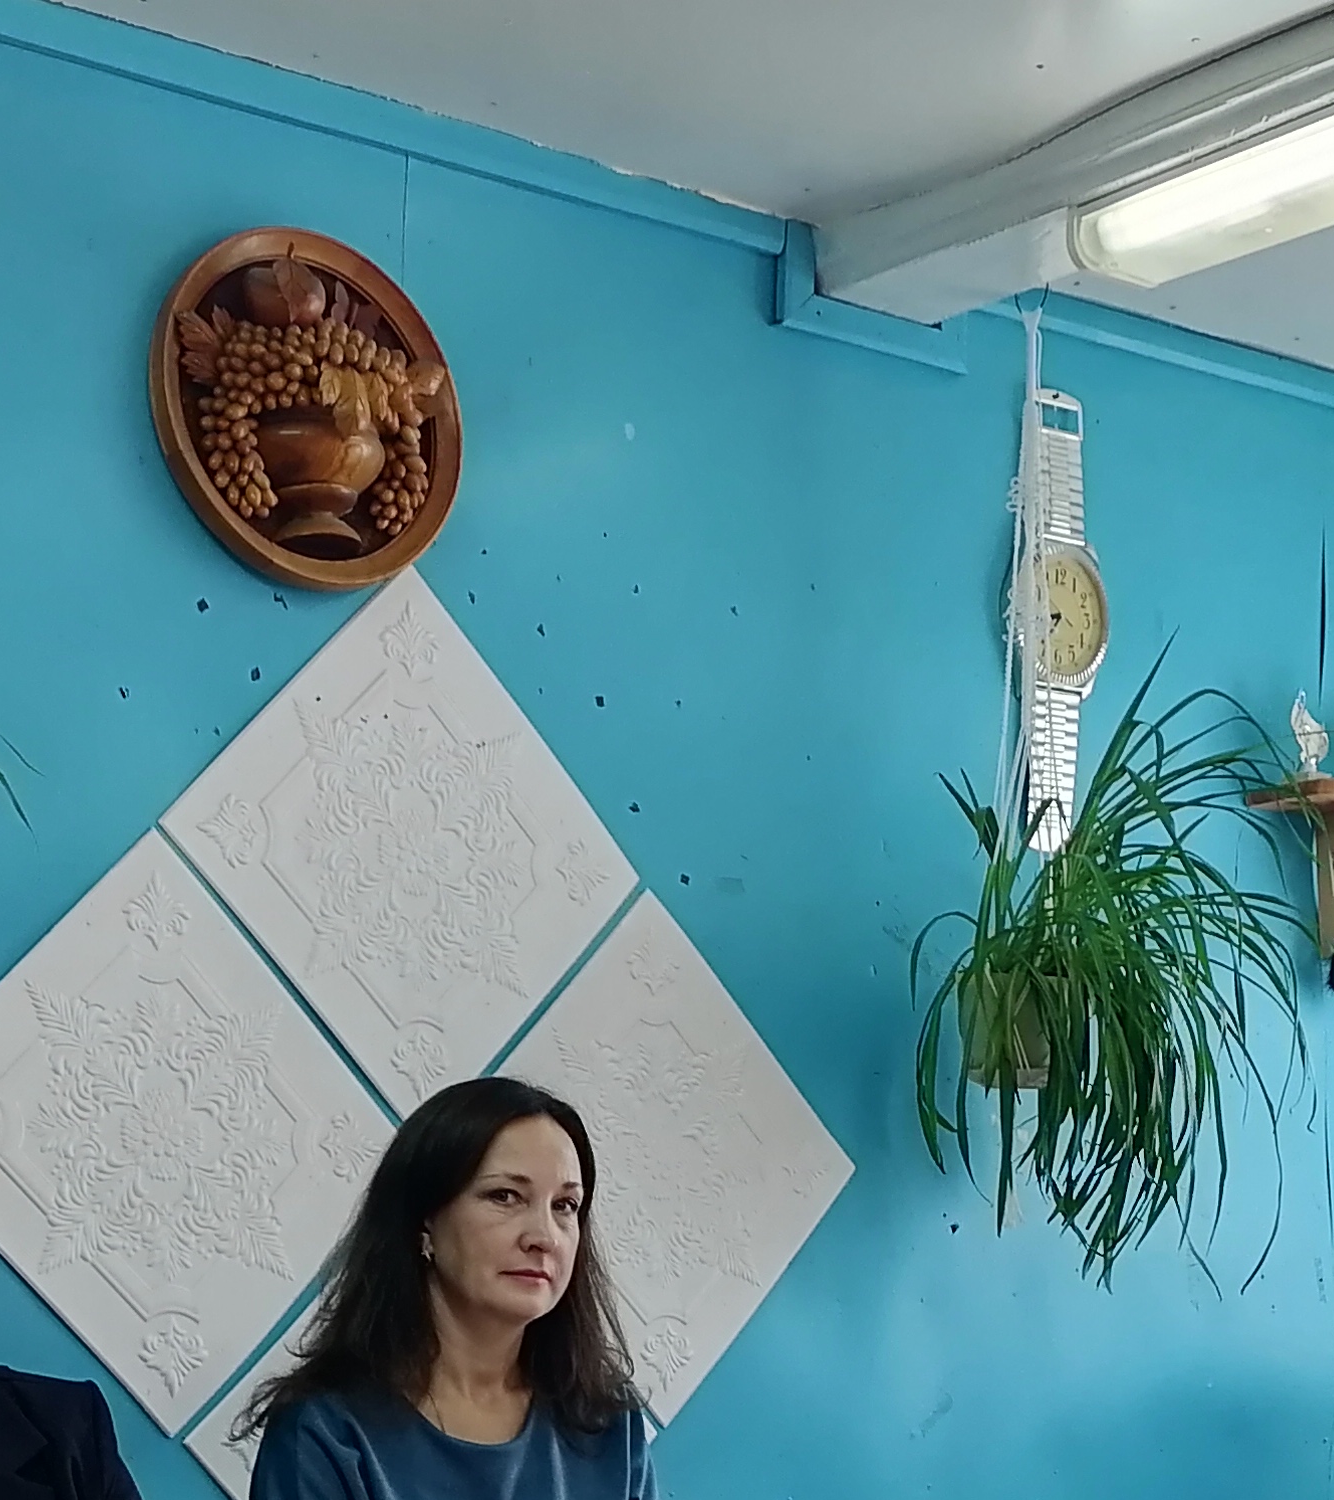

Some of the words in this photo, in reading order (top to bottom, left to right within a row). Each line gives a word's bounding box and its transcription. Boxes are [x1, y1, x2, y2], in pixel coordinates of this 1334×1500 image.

[1055, 568, 1067, 585] 12
[1072, 577, 1077, 593] 1
[1080, 592, 1088, 609] 2
[1083, 612, 1091, 630] 3
[1054, 649, 1063, 665] 6
[1068, 644, 1076, 662] 5
